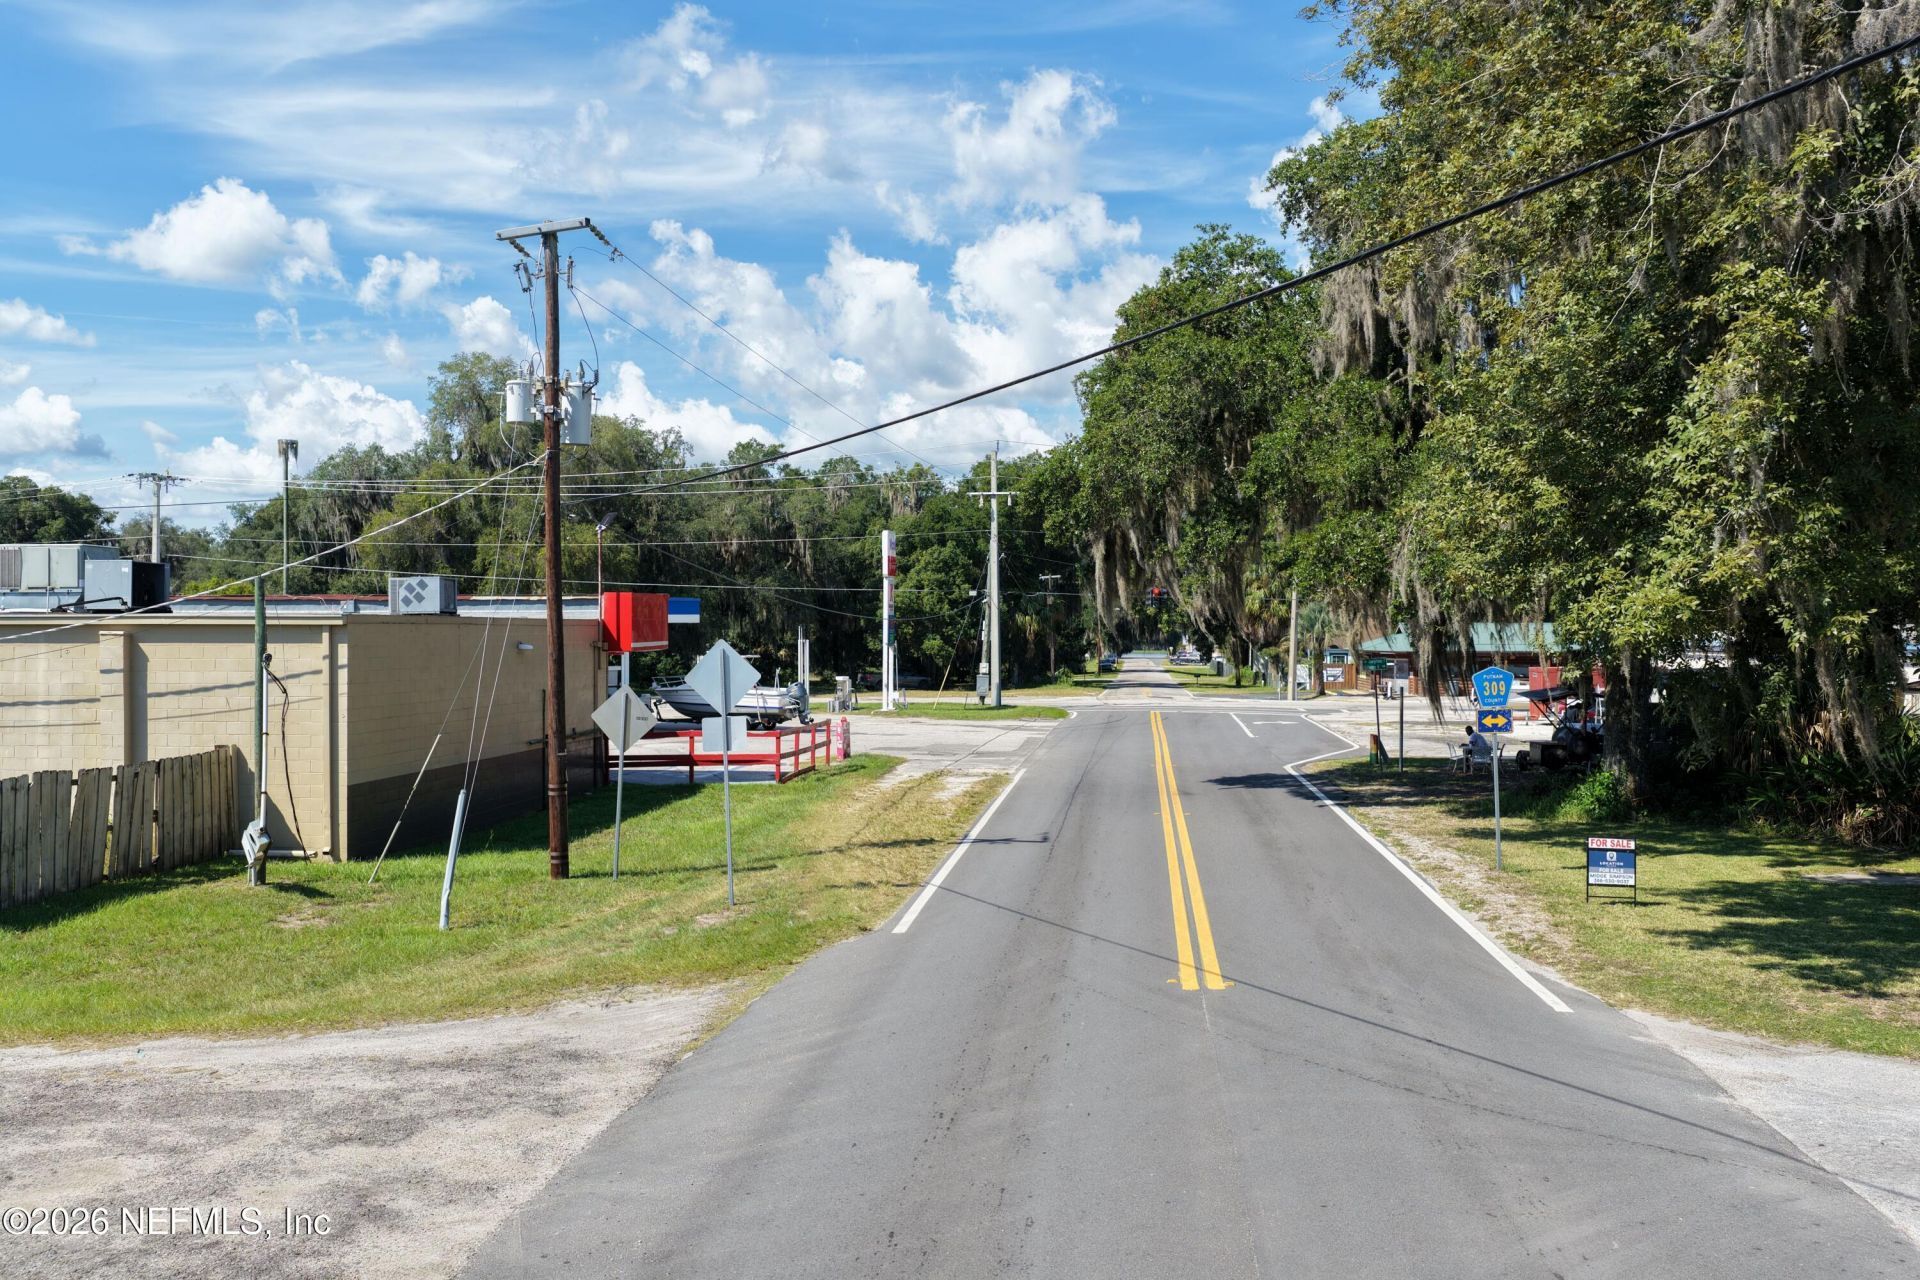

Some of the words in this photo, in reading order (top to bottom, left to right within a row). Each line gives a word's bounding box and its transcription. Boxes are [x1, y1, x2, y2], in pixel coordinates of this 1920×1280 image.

[1483, 681, 1505, 696] 309
[1590, 839, 1607, 847] FOR
[1610, 840, 1632, 848] SALE
